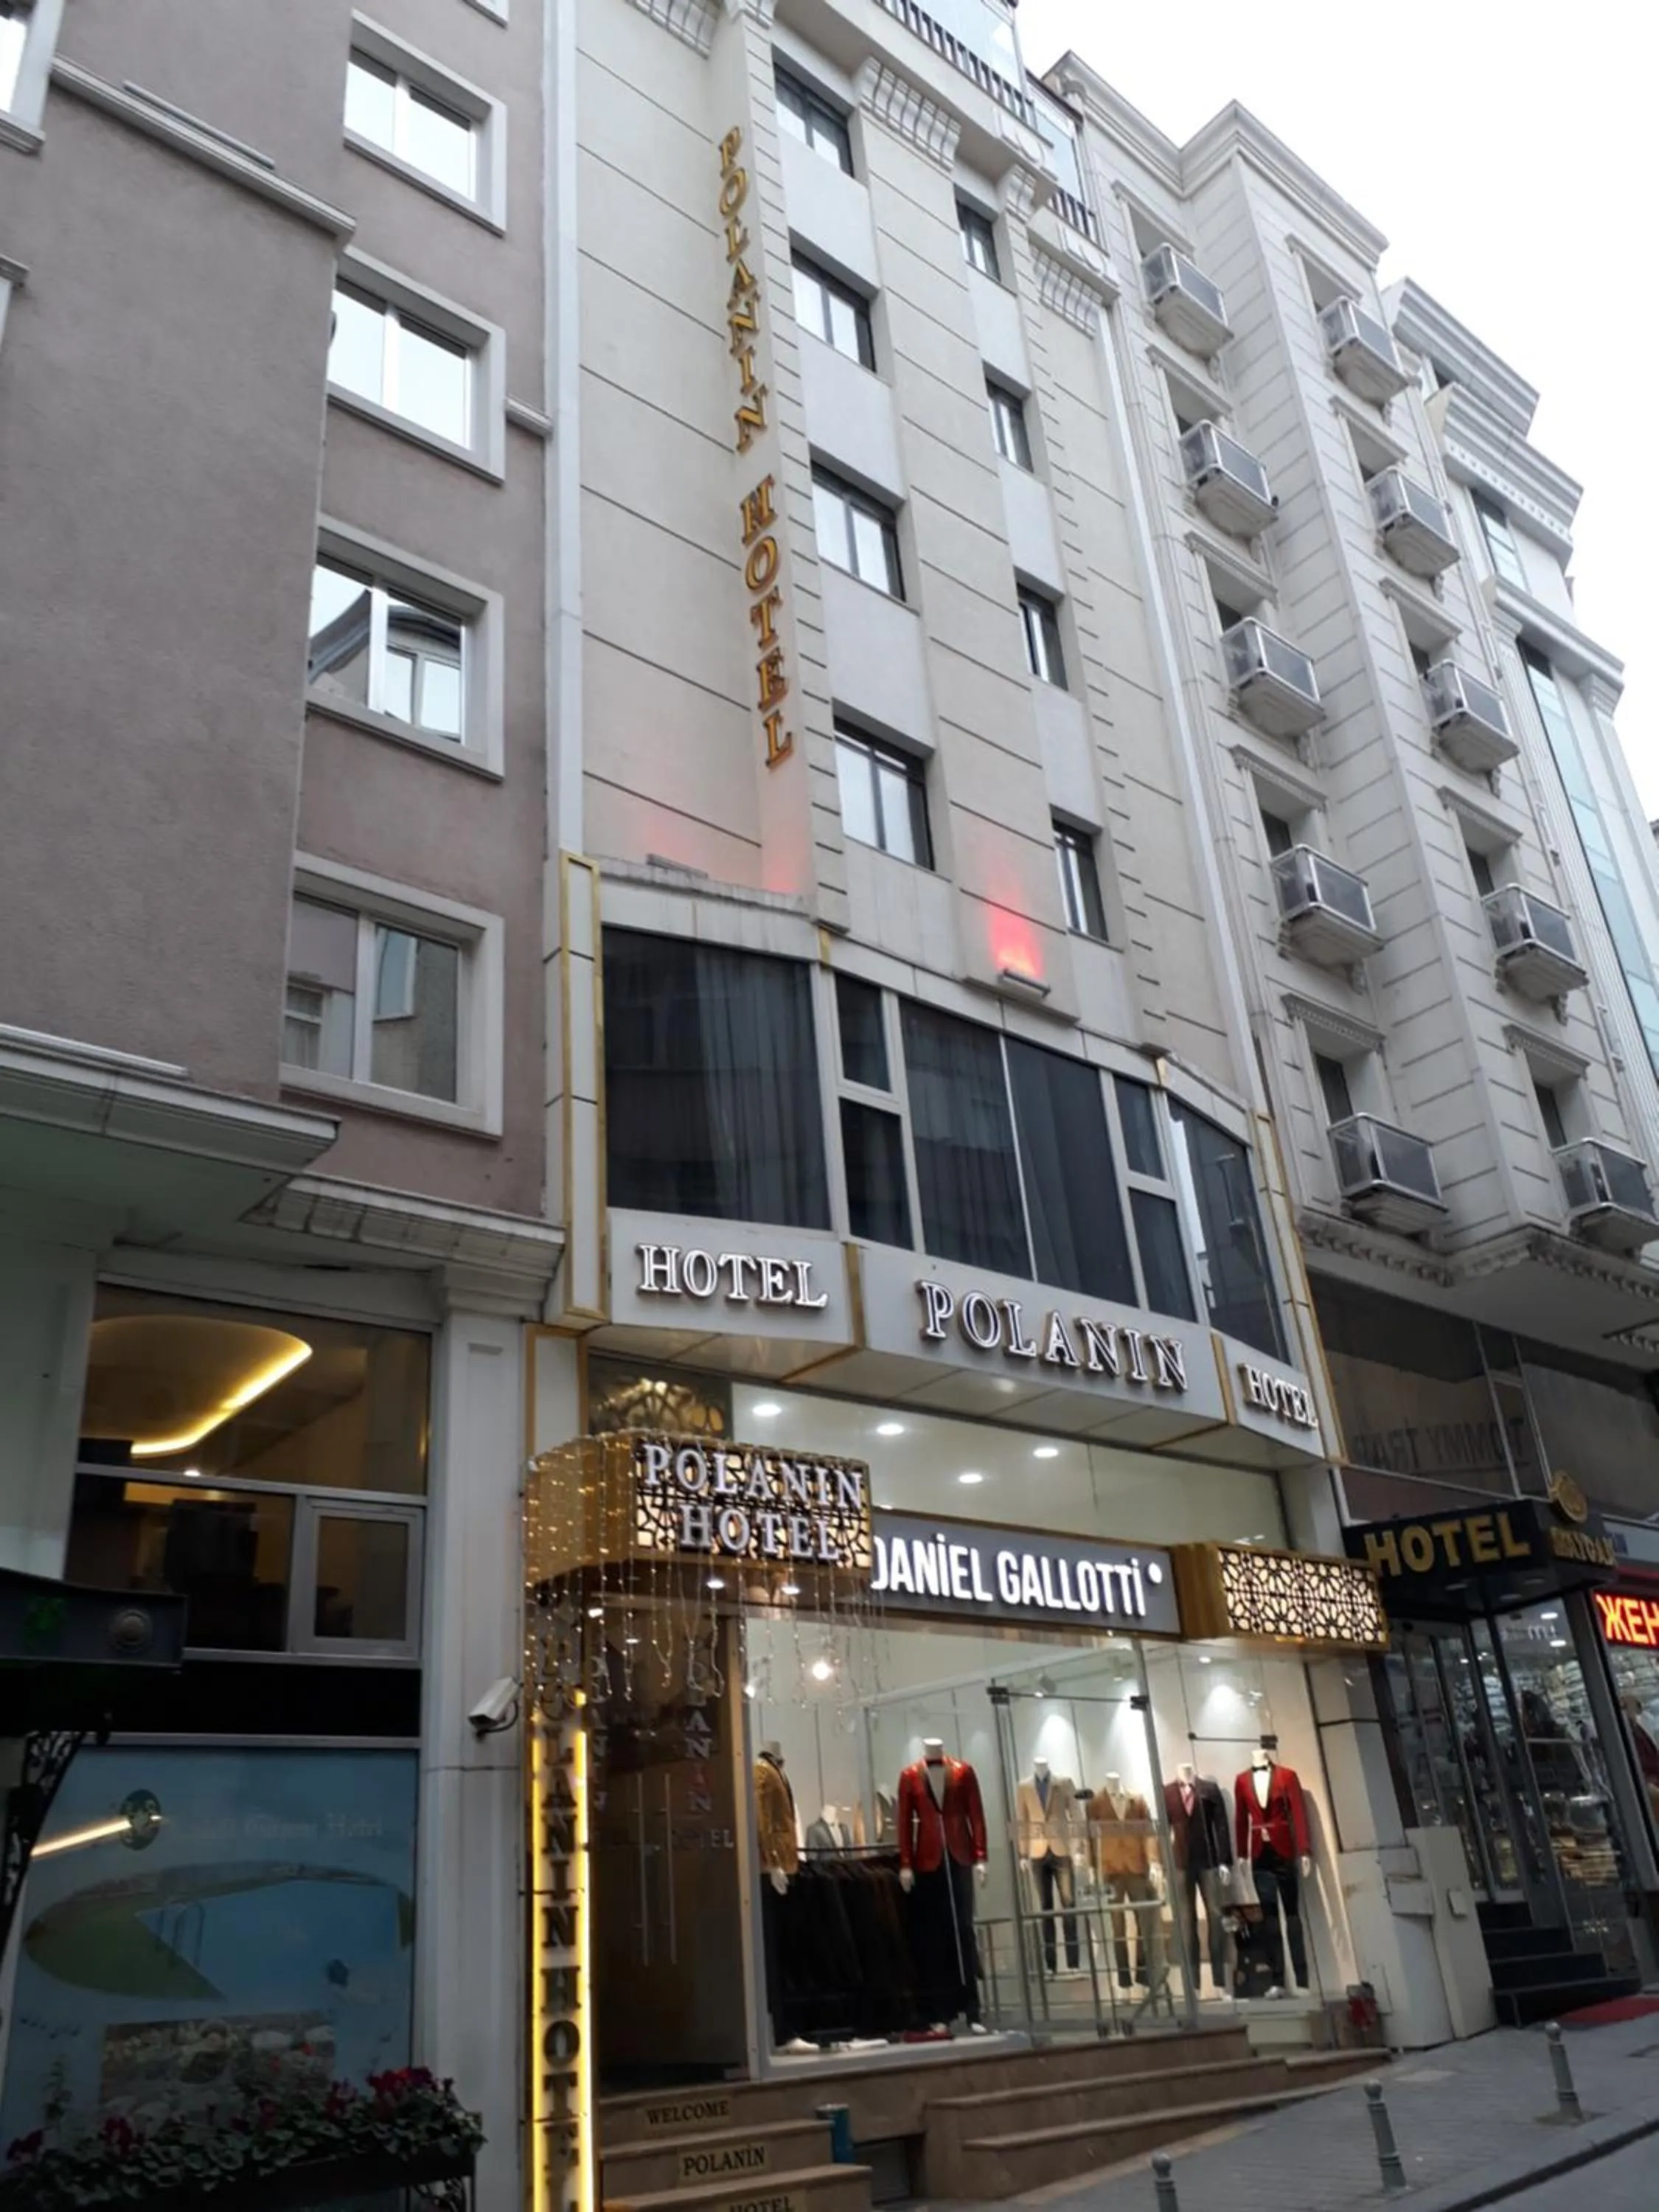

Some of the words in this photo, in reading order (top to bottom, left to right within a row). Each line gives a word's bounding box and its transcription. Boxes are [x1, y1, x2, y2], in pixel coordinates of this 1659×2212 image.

[717, 126, 768, 452] POLANIN
[739, 473, 793, 773] HOTEL
[637, 1244, 828, 1308] HOTEL
[917, 1280, 1189, 1391] POLANIN
[1237, 1363, 1318, 1428] HOTEL
[644, 1444, 863, 1511] POLANIN
[678, 1503, 841, 1560] HOTEL
[1364, 1512, 1531, 1578] HOTEL
[646, 2101, 730, 2126] WELCOME
